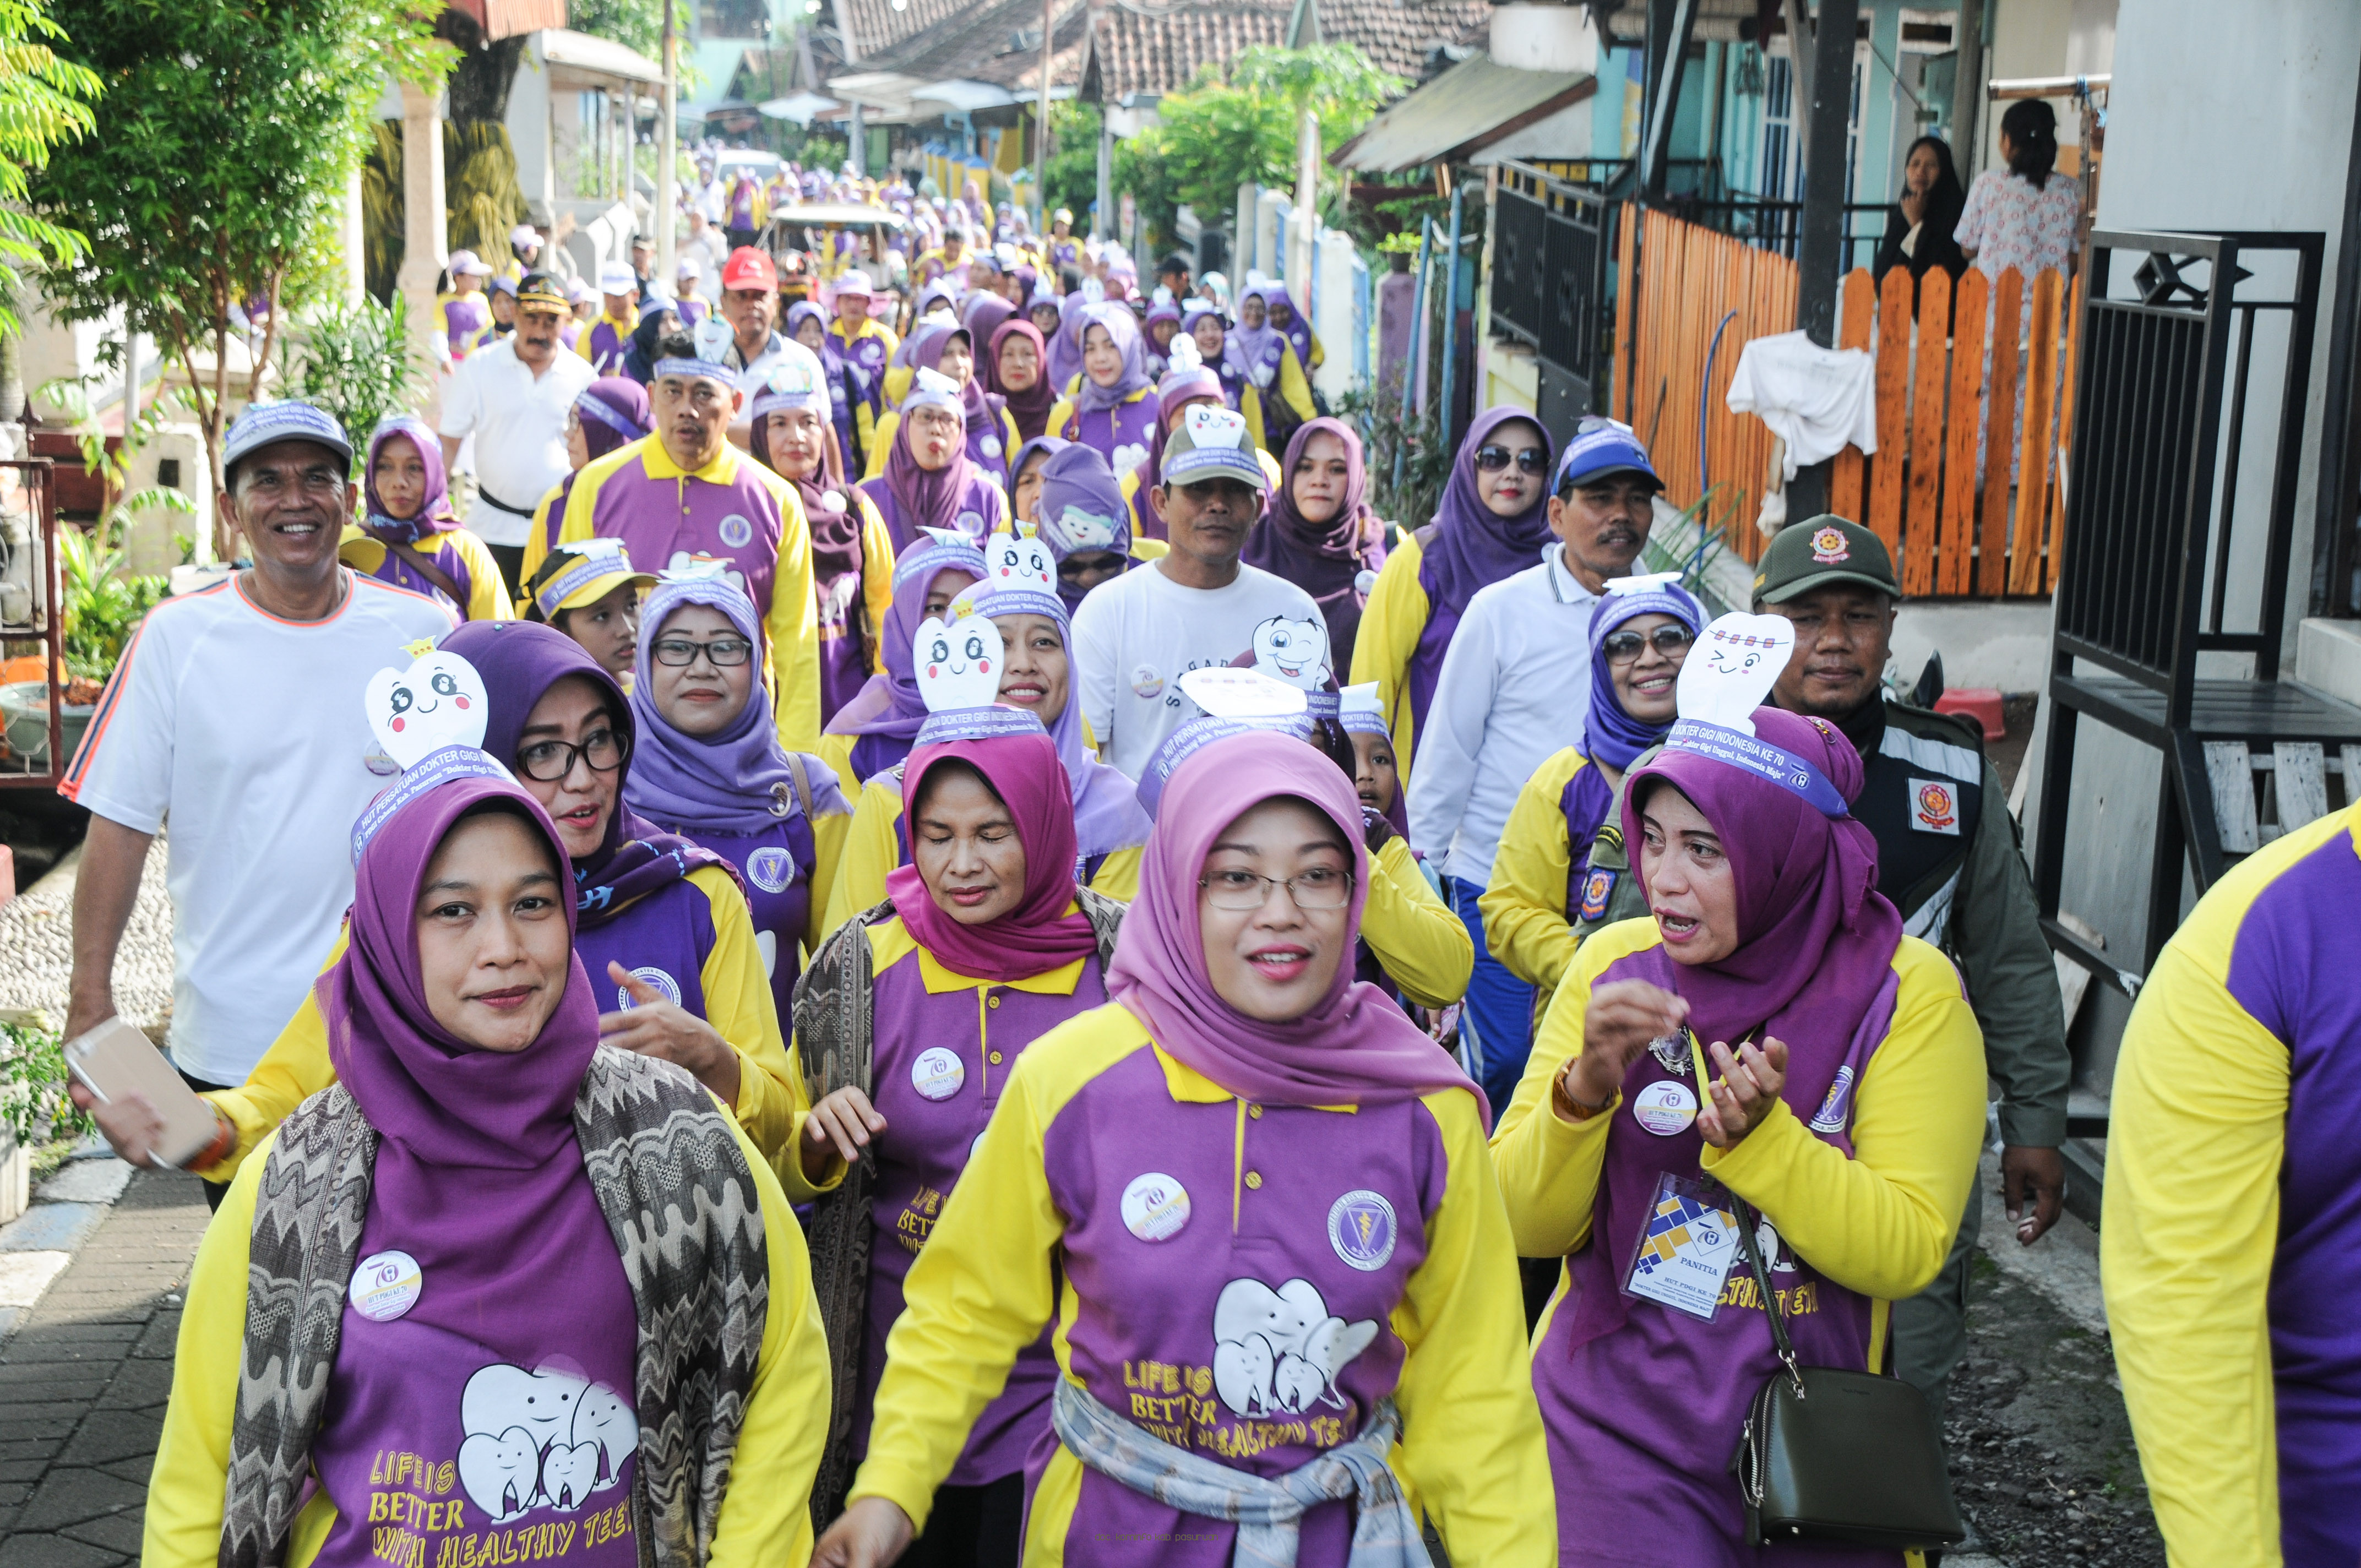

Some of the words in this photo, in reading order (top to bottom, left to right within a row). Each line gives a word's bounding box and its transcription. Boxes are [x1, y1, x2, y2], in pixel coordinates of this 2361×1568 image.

[1675, 724, 1699, 737] DOKTER
[1699, 727, 1716, 741] GIGI
[1715, 729, 1760, 757] INDONESIA
[1760, 747, 1773, 761] KE
[1772, 753, 1785, 766] 70
[361, 809, 377, 830] HUT
[376, 770, 420, 815] PERSATUAN
[419, 749, 459, 777] DOKTER
[459, 749, 479, 762] GIGI
[1680, 1256, 1718, 1276] PANITIA
[368, 1295, 379, 1304] HUT
[379, 1289, 393, 1300] PDGI
[393, 1287, 401, 1295] KE
[400, 1285, 407, 1293] 70
[1664, 1277, 1678, 1286] HUT
[1679, 1282, 1696, 1292] PDGI
[1696, 1288, 1708, 1296] KE
[1123, 1359, 1180, 1393] LIFE
[1184, 1365, 1213, 1397] IS
[1130, 1392, 1218, 1425] BETTER
[369, 1449, 423, 1489] LIFE
[424, 1459, 456, 1494] IS
[368, 1491, 465, 1532] BETTER
[373, 1526, 427, 1568] WITH
[436, 1520, 576, 1568] HEALTHY
